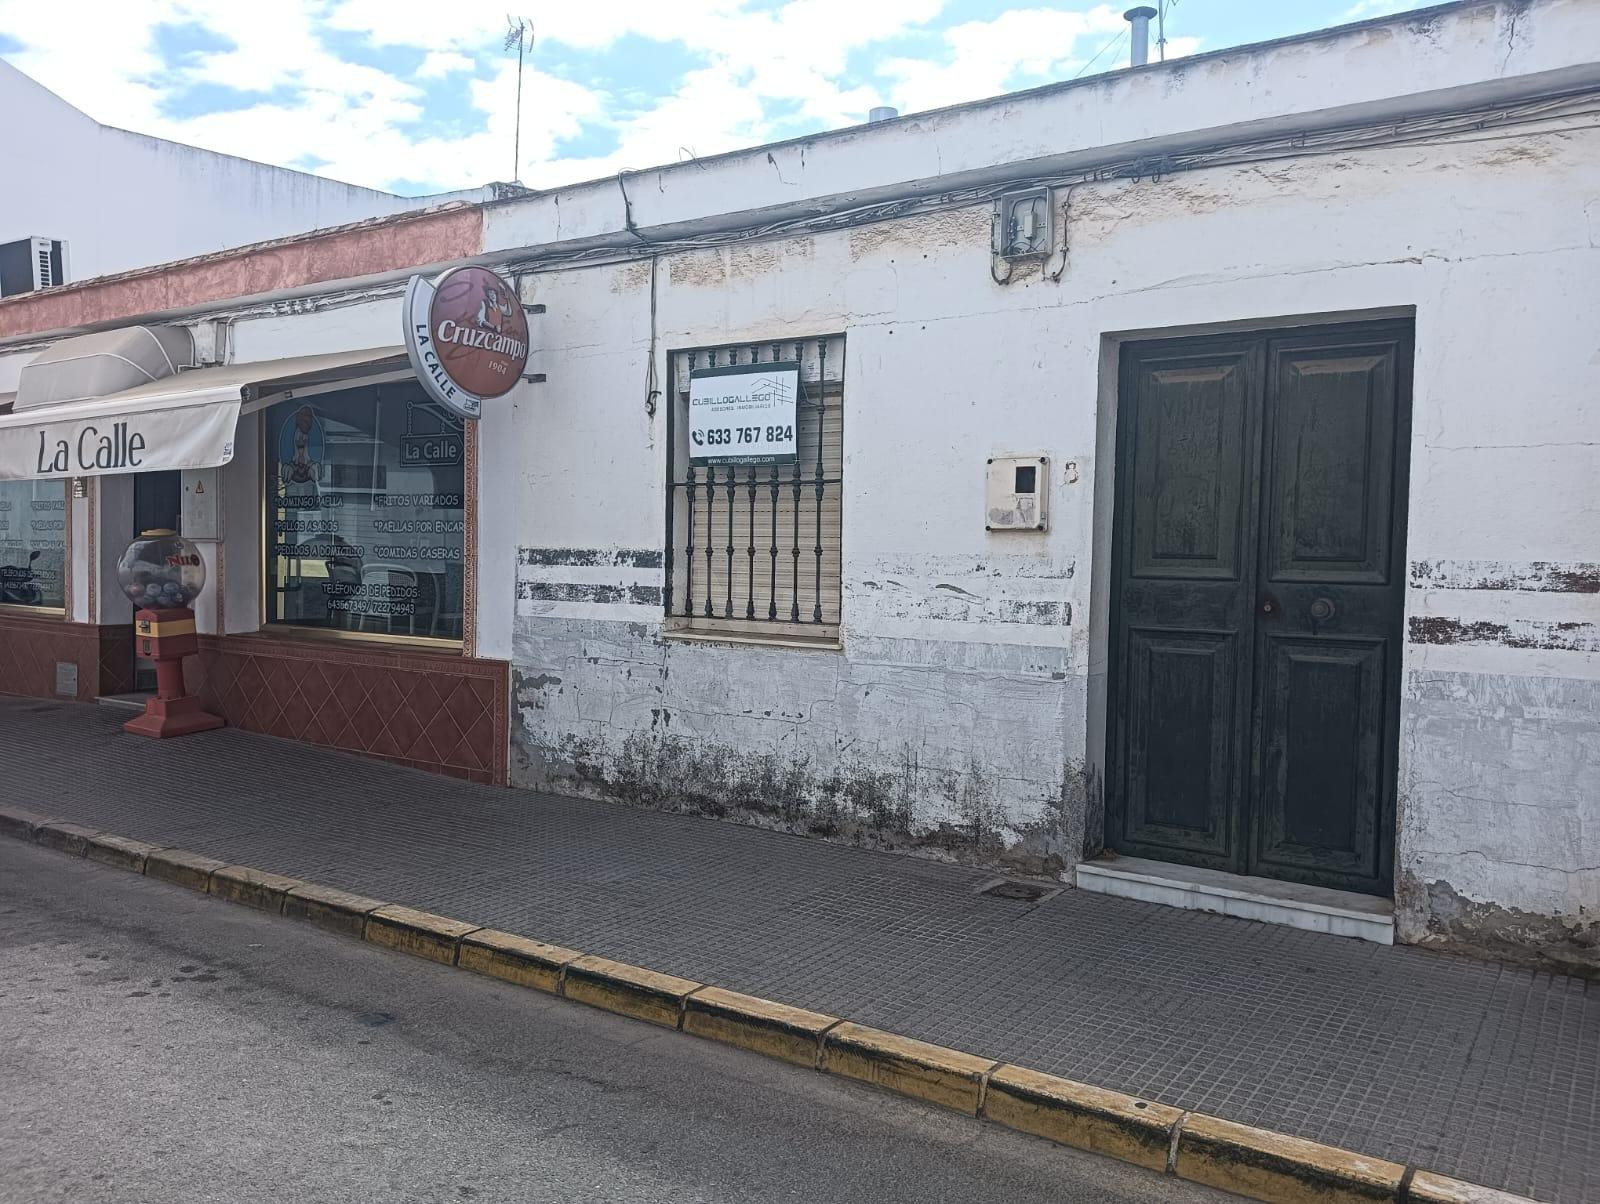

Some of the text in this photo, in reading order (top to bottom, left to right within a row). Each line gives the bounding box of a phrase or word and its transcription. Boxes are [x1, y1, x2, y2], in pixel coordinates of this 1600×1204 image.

[437, 319, 526, 361] Cruzcampo
[415, 324, 456, 399] LA CALLE
[488, 360, 507, 375] 1904
[692, 392, 771, 406] CUBILLOGALLEGO
[707, 425, 793, 445] 633 767 824
[36, 421, 146, 474] La Calle
[405, 440, 457, 459] La Calle
[412, 494, 459, 506] VARIADOS
[306, 520, 338, 531] ASADOS
[416, 521, 433, 532] POR
[311, 545, 318, 556] A
[320, 545, 365, 557] DOMICILIO
[420, 547, 460, 559] CASERAS
[322, 580, 367, 595] TELÉFONOS
[368, 584, 380, 596] DE
[373, 601, 415, 614] 722794943
